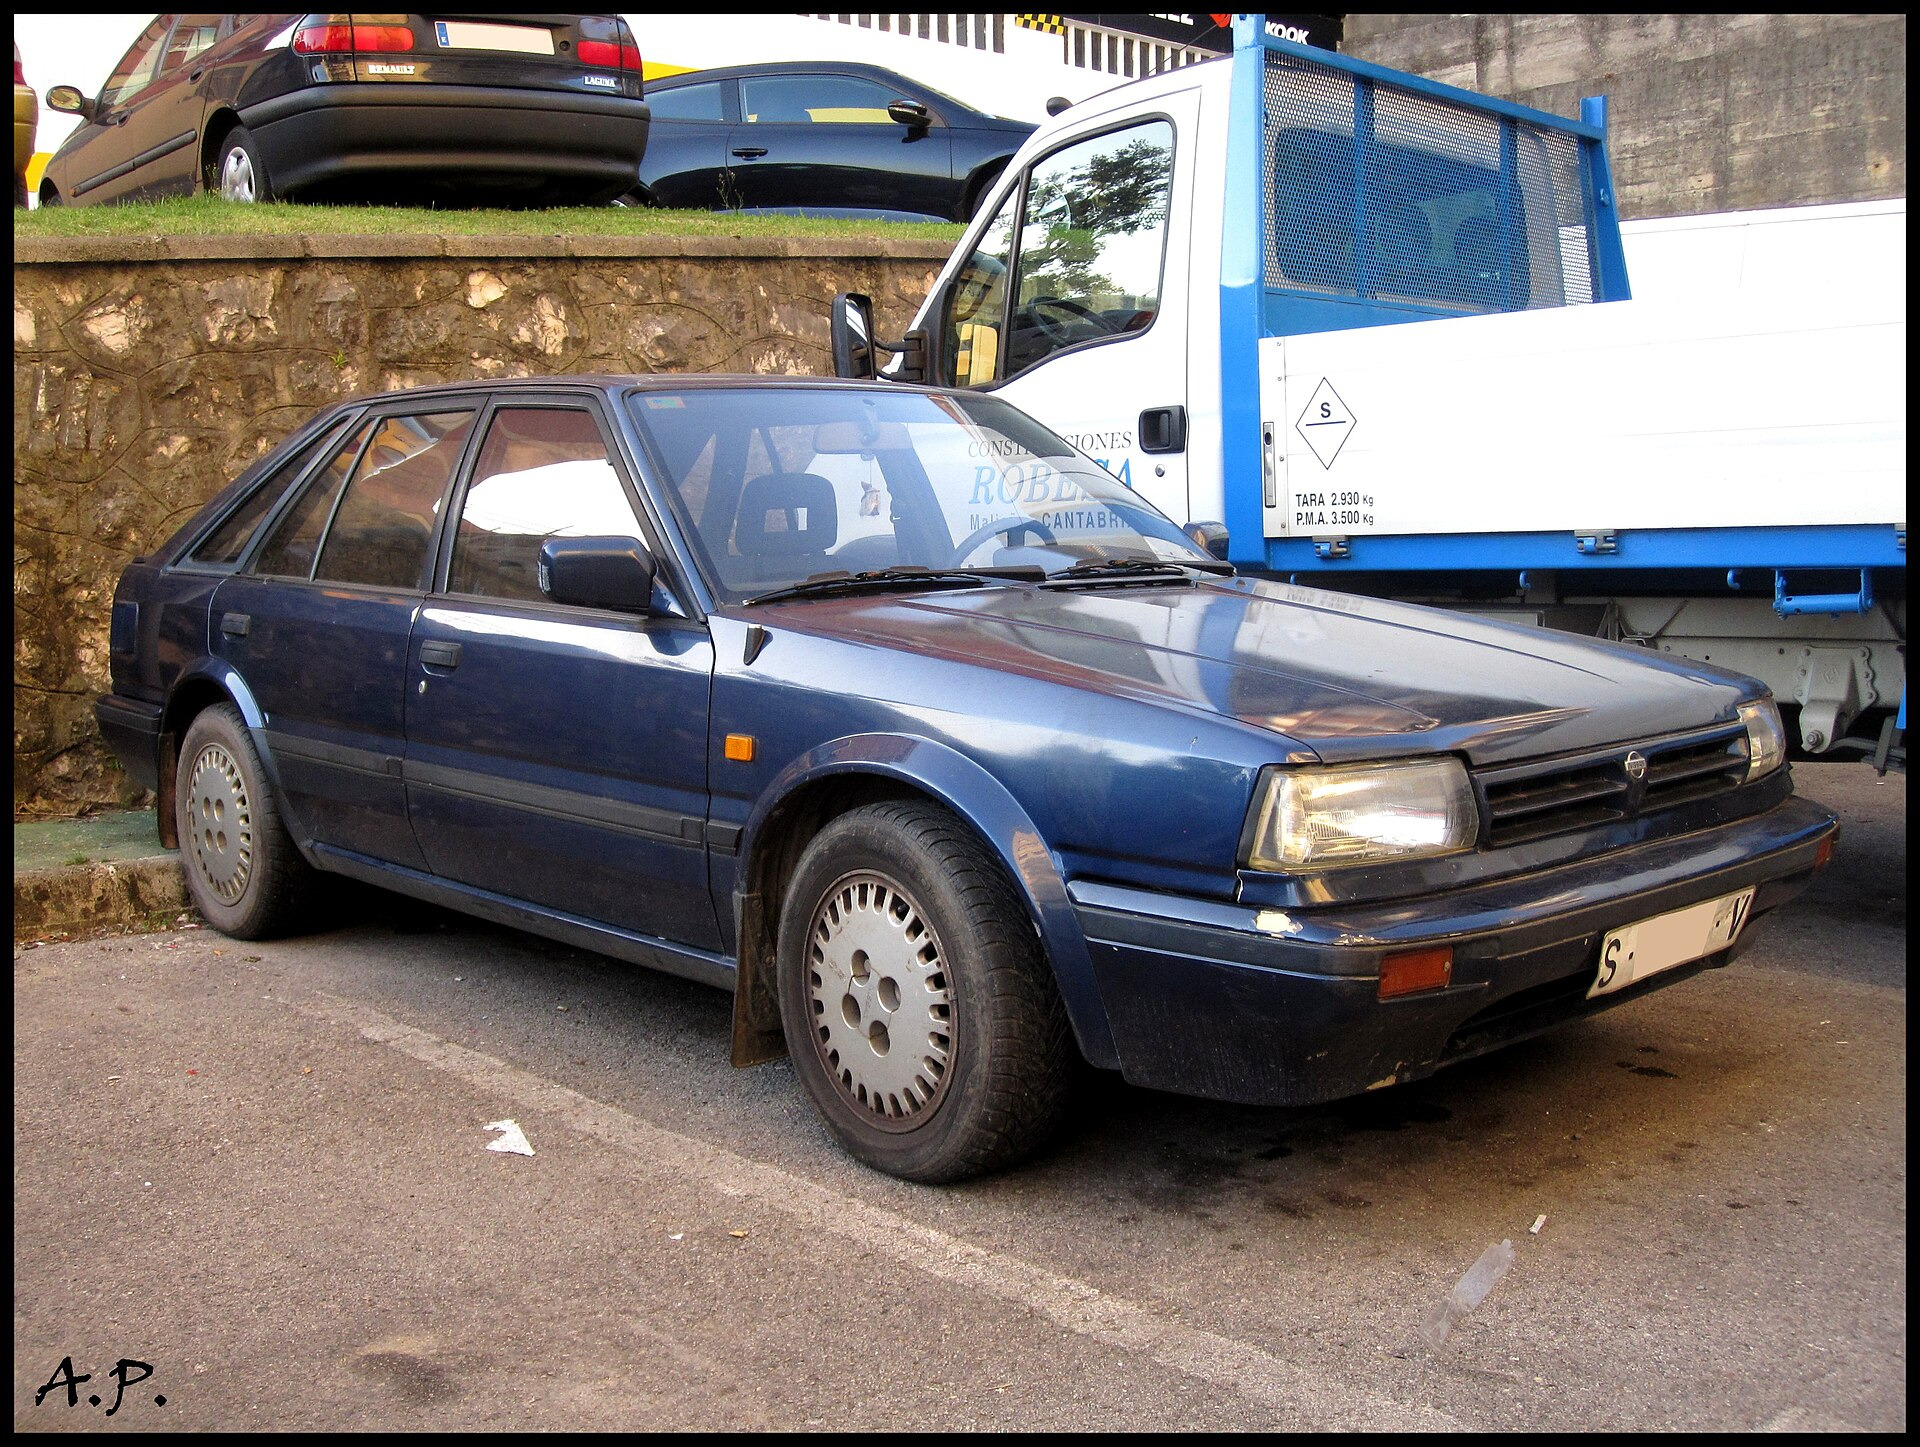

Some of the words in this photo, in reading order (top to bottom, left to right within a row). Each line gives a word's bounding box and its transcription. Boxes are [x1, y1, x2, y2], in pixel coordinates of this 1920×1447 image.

[1264, 21, 1310, 45] KOOK
[584, 76, 616, 88] LAGUNA
[1320, 402, 1331, 418] S
[1296, 493, 1325, 507] TARA
[1331, 492, 1360, 506] 2.930
[1363, 495, 1374, 506] Kg
[1042, 511, 1131, 529] CANTABRI
[1296, 512, 1328, 525] P.M.A.
[1331, 511, 1360, 525] 3.500
[1363, 514, 1374, 525] Kg
